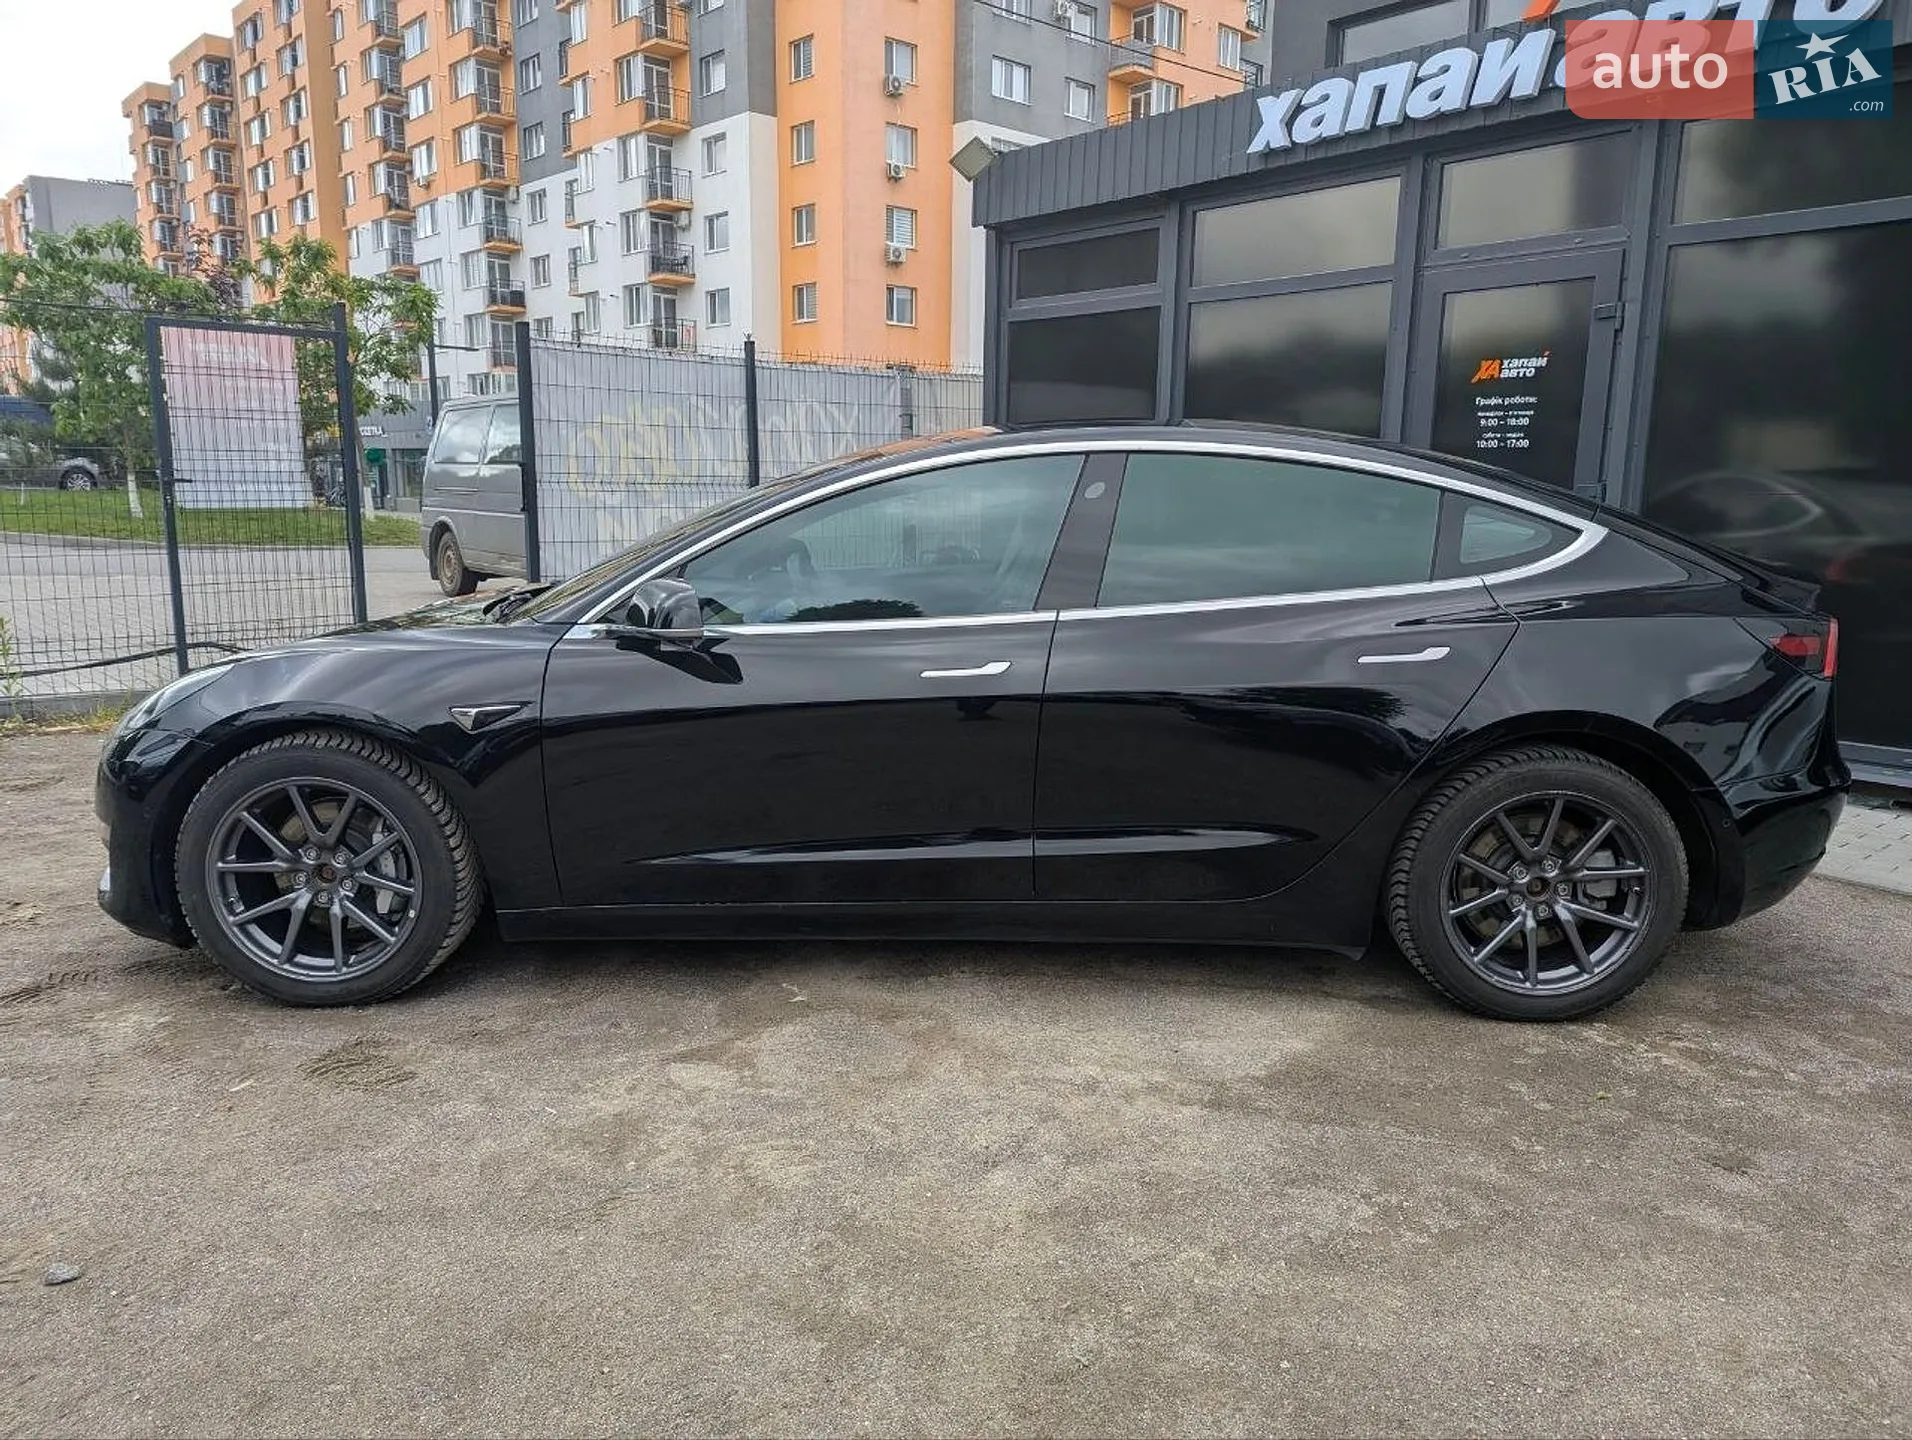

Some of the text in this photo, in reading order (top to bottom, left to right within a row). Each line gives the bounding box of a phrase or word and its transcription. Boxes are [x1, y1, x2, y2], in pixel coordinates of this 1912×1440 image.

[1501, 350, 1551, 369] хапай
[1500, 367, 1536, 379] авто
[1480, 418, 1498, 427] 9:00
[1507, 416, 1530, 426] 18:00
[1476, 439, 1498, 448] 10:00
[1507, 439, 1530, 448] 17:00
